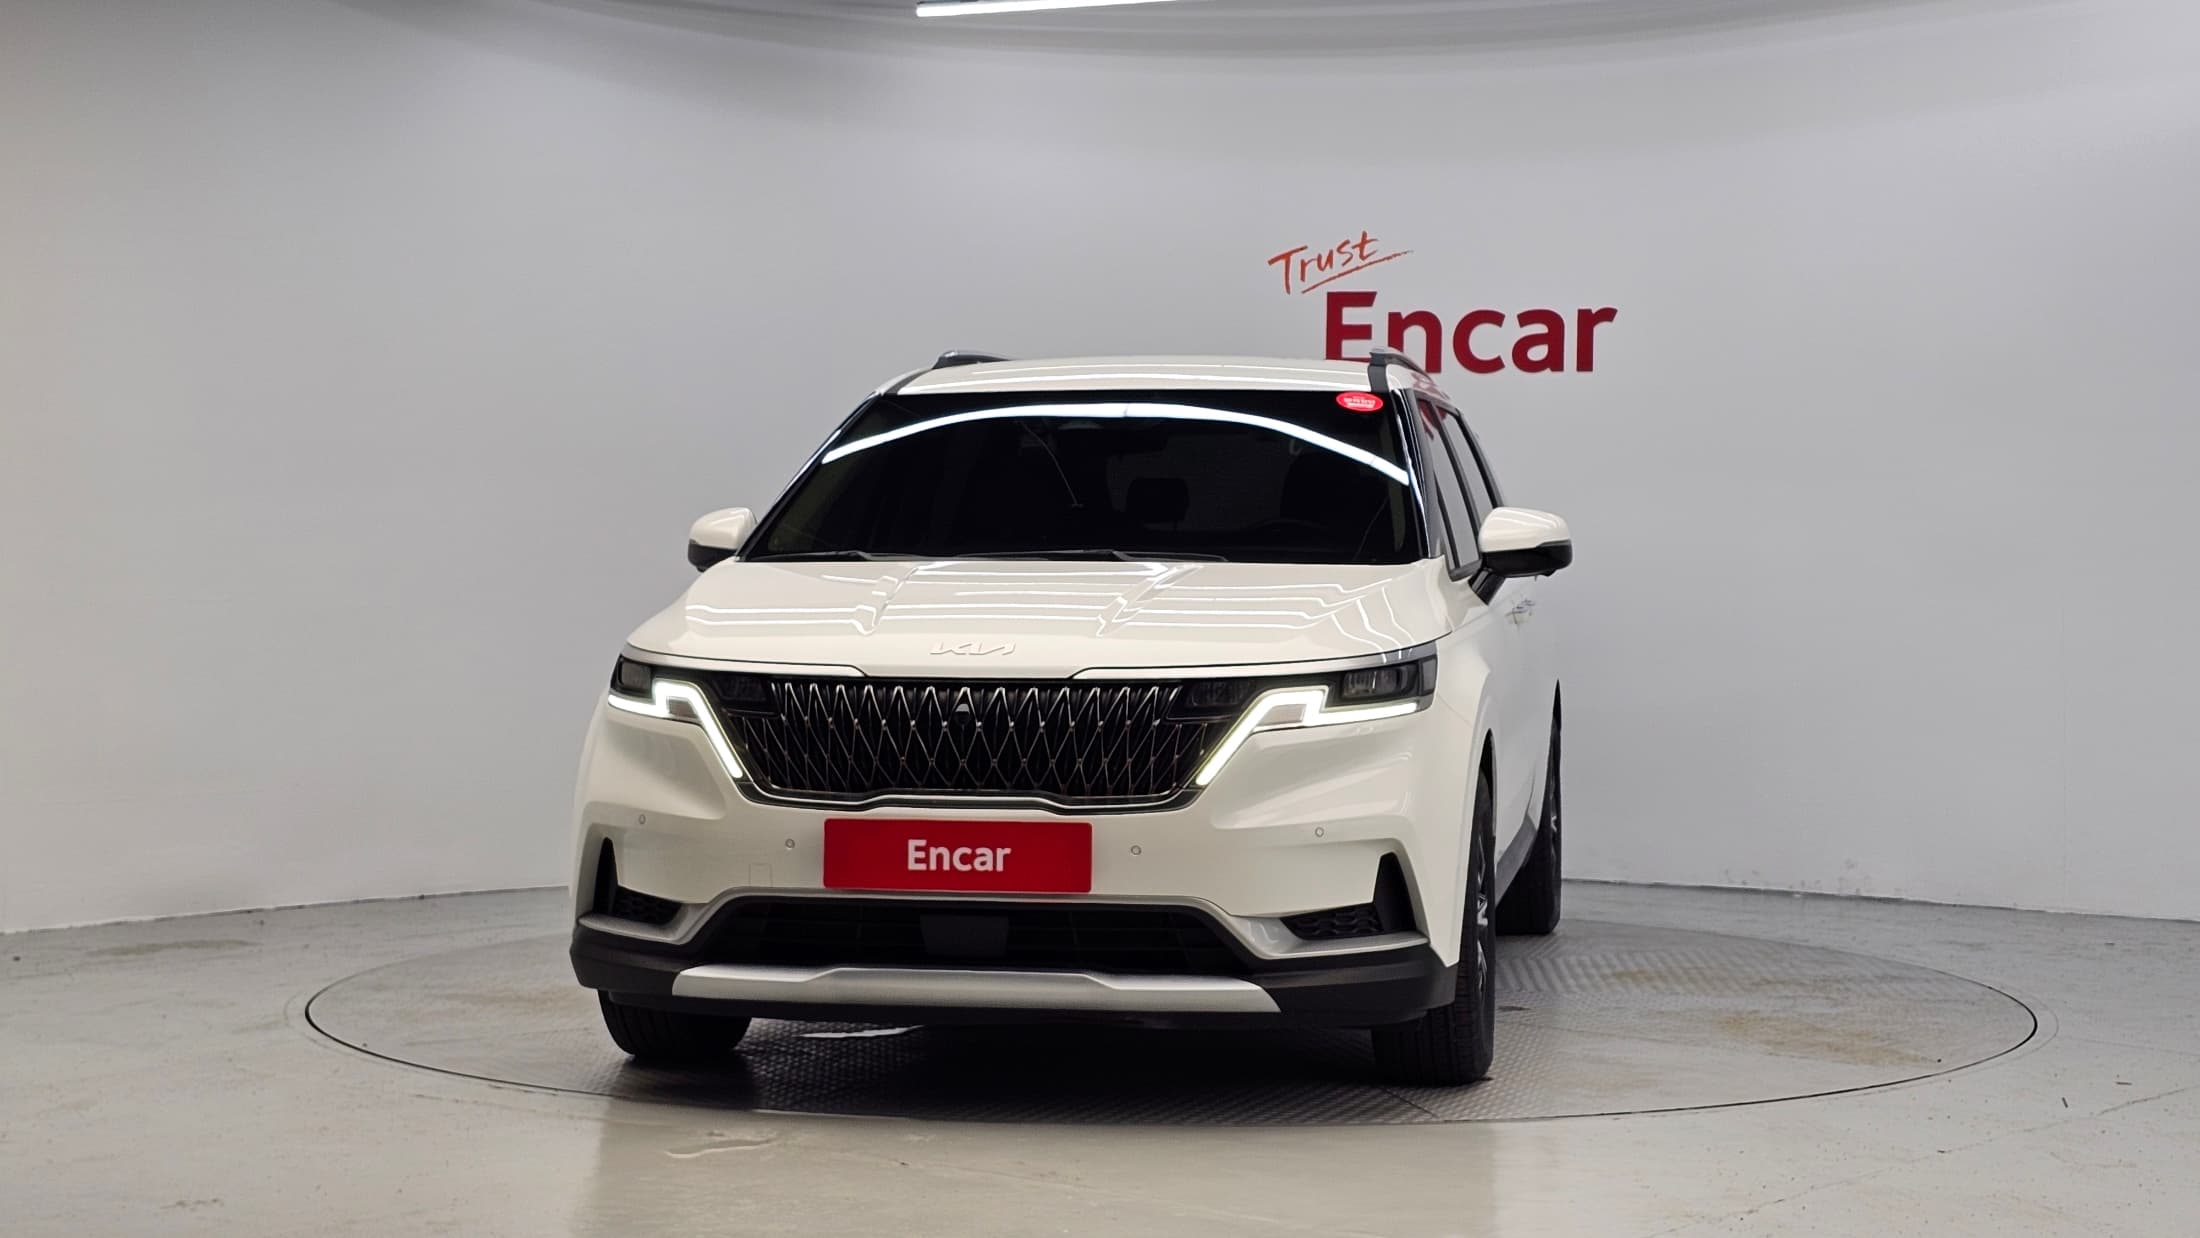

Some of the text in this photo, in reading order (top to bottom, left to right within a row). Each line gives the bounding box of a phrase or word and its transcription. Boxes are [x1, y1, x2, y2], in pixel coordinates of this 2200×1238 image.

[1268, 231, 1378, 294] Trust
[1325, 291, 1618, 374] Encar
[907, 839, 1012, 872] Encar
